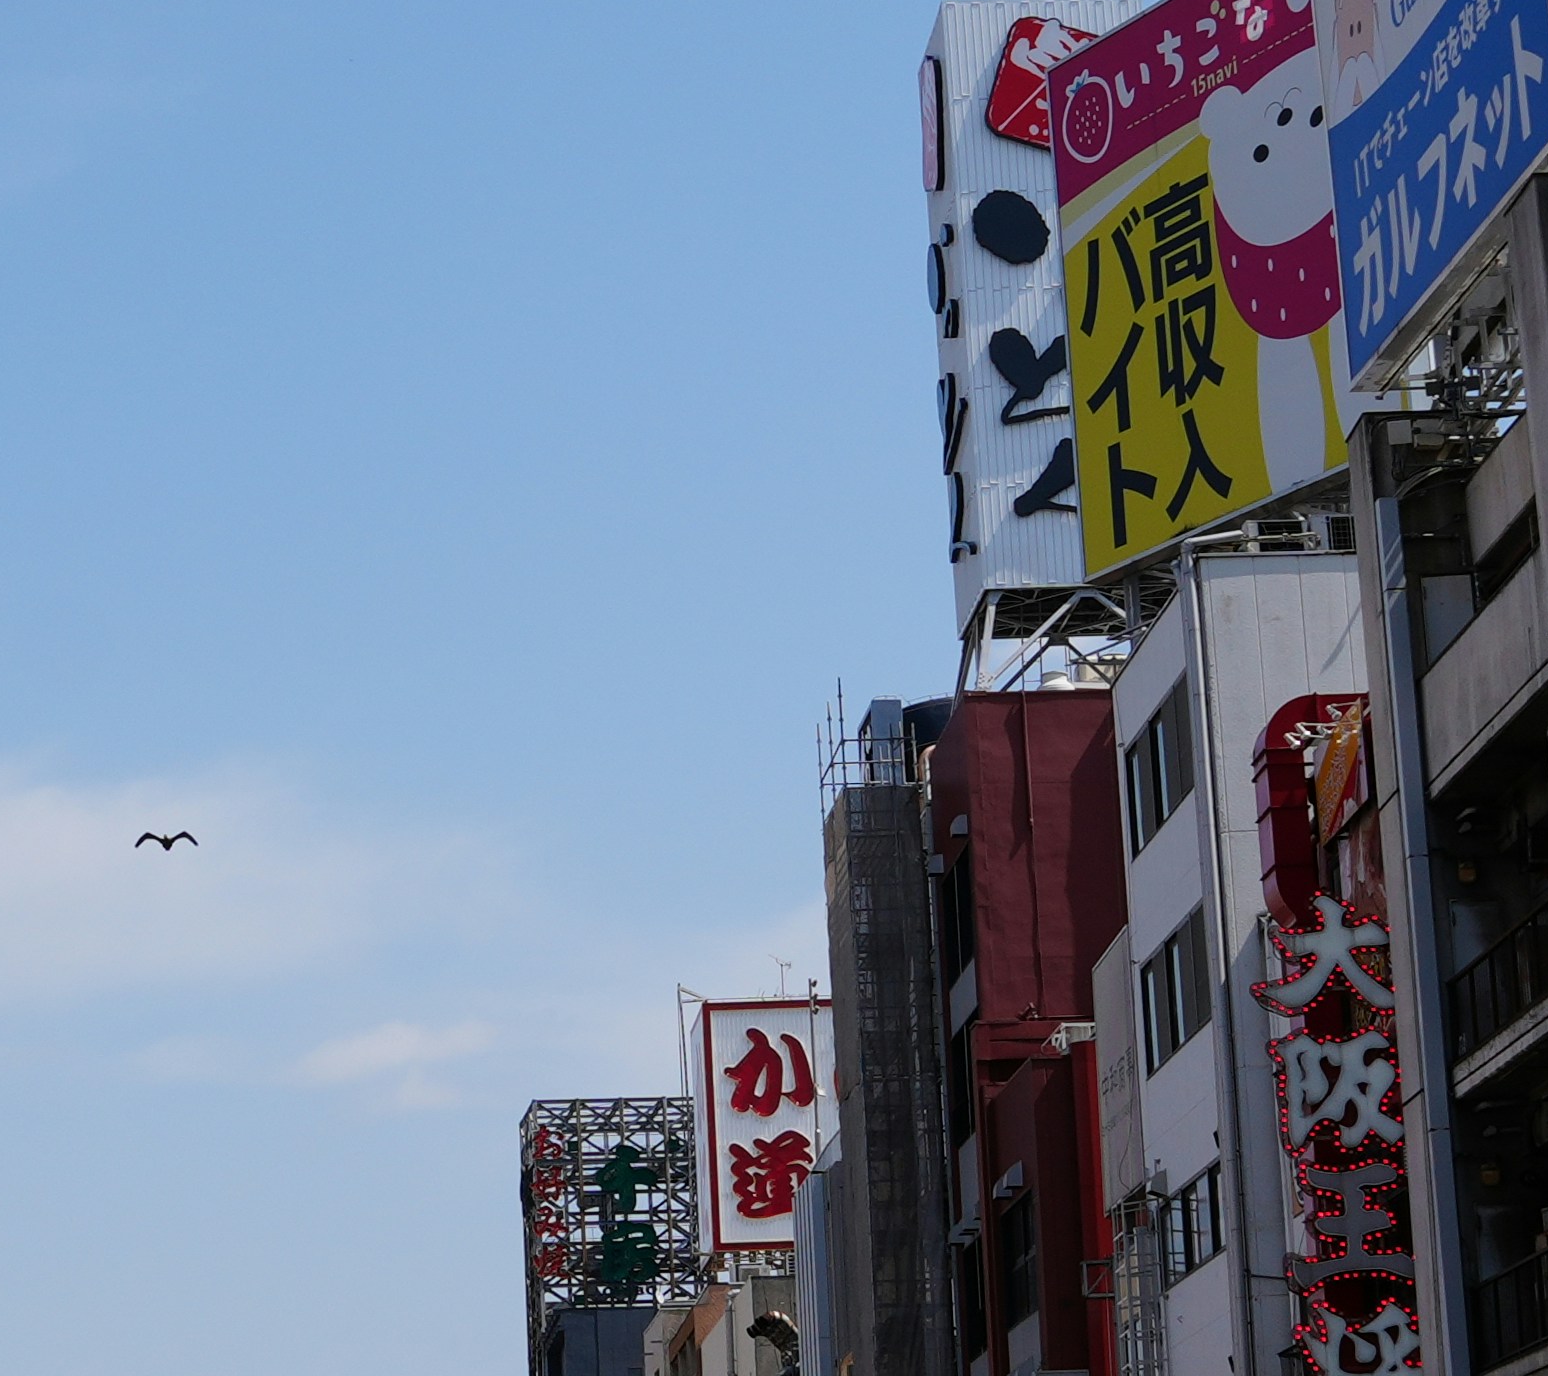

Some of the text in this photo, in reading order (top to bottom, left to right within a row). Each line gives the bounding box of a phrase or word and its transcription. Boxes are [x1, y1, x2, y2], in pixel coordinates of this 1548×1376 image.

[1191, 56, 1239, 99] 15navi
[1353, 23, 1545, 340] ガルフネット
[1081, 209, 1158, 549] バイト
[1146, 171, 1232, 523] 高収入
[532, 1124, 569, 1280] お好み焼
